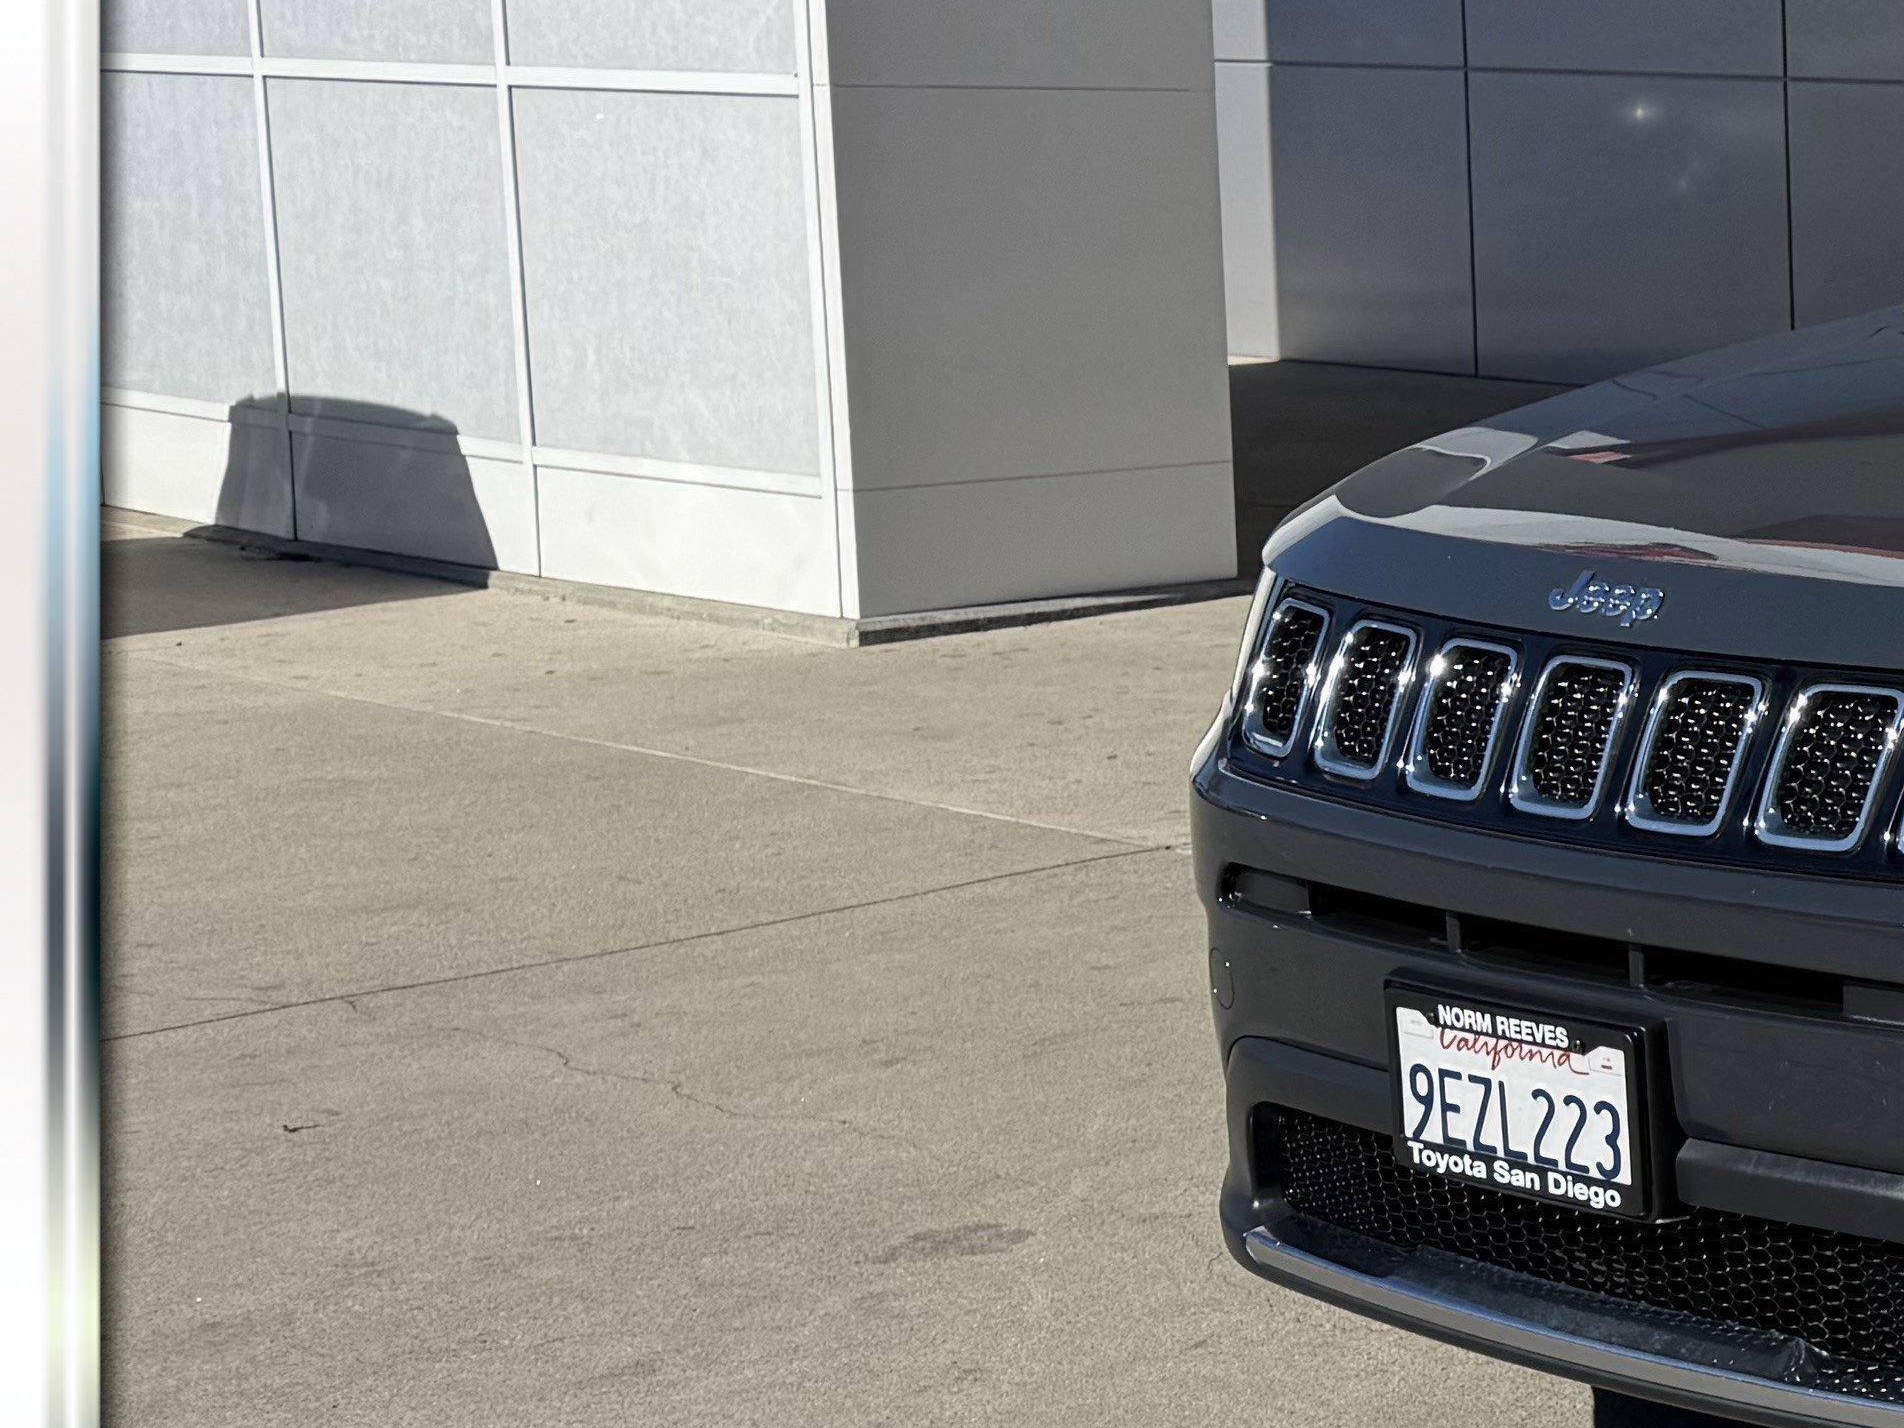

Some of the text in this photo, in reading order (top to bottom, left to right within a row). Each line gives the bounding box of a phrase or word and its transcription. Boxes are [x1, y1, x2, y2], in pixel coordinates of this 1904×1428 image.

[1548, 570, 1664, 628] Jeep
[1437, 1004, 1569, 1049] NORM REEVES
[1438, 1027, 1590, 1076] California
[1408, 1062, 1622, 1181] 9EZL223
[1407, 1140, 1622, 1209] Toyota San Diego
